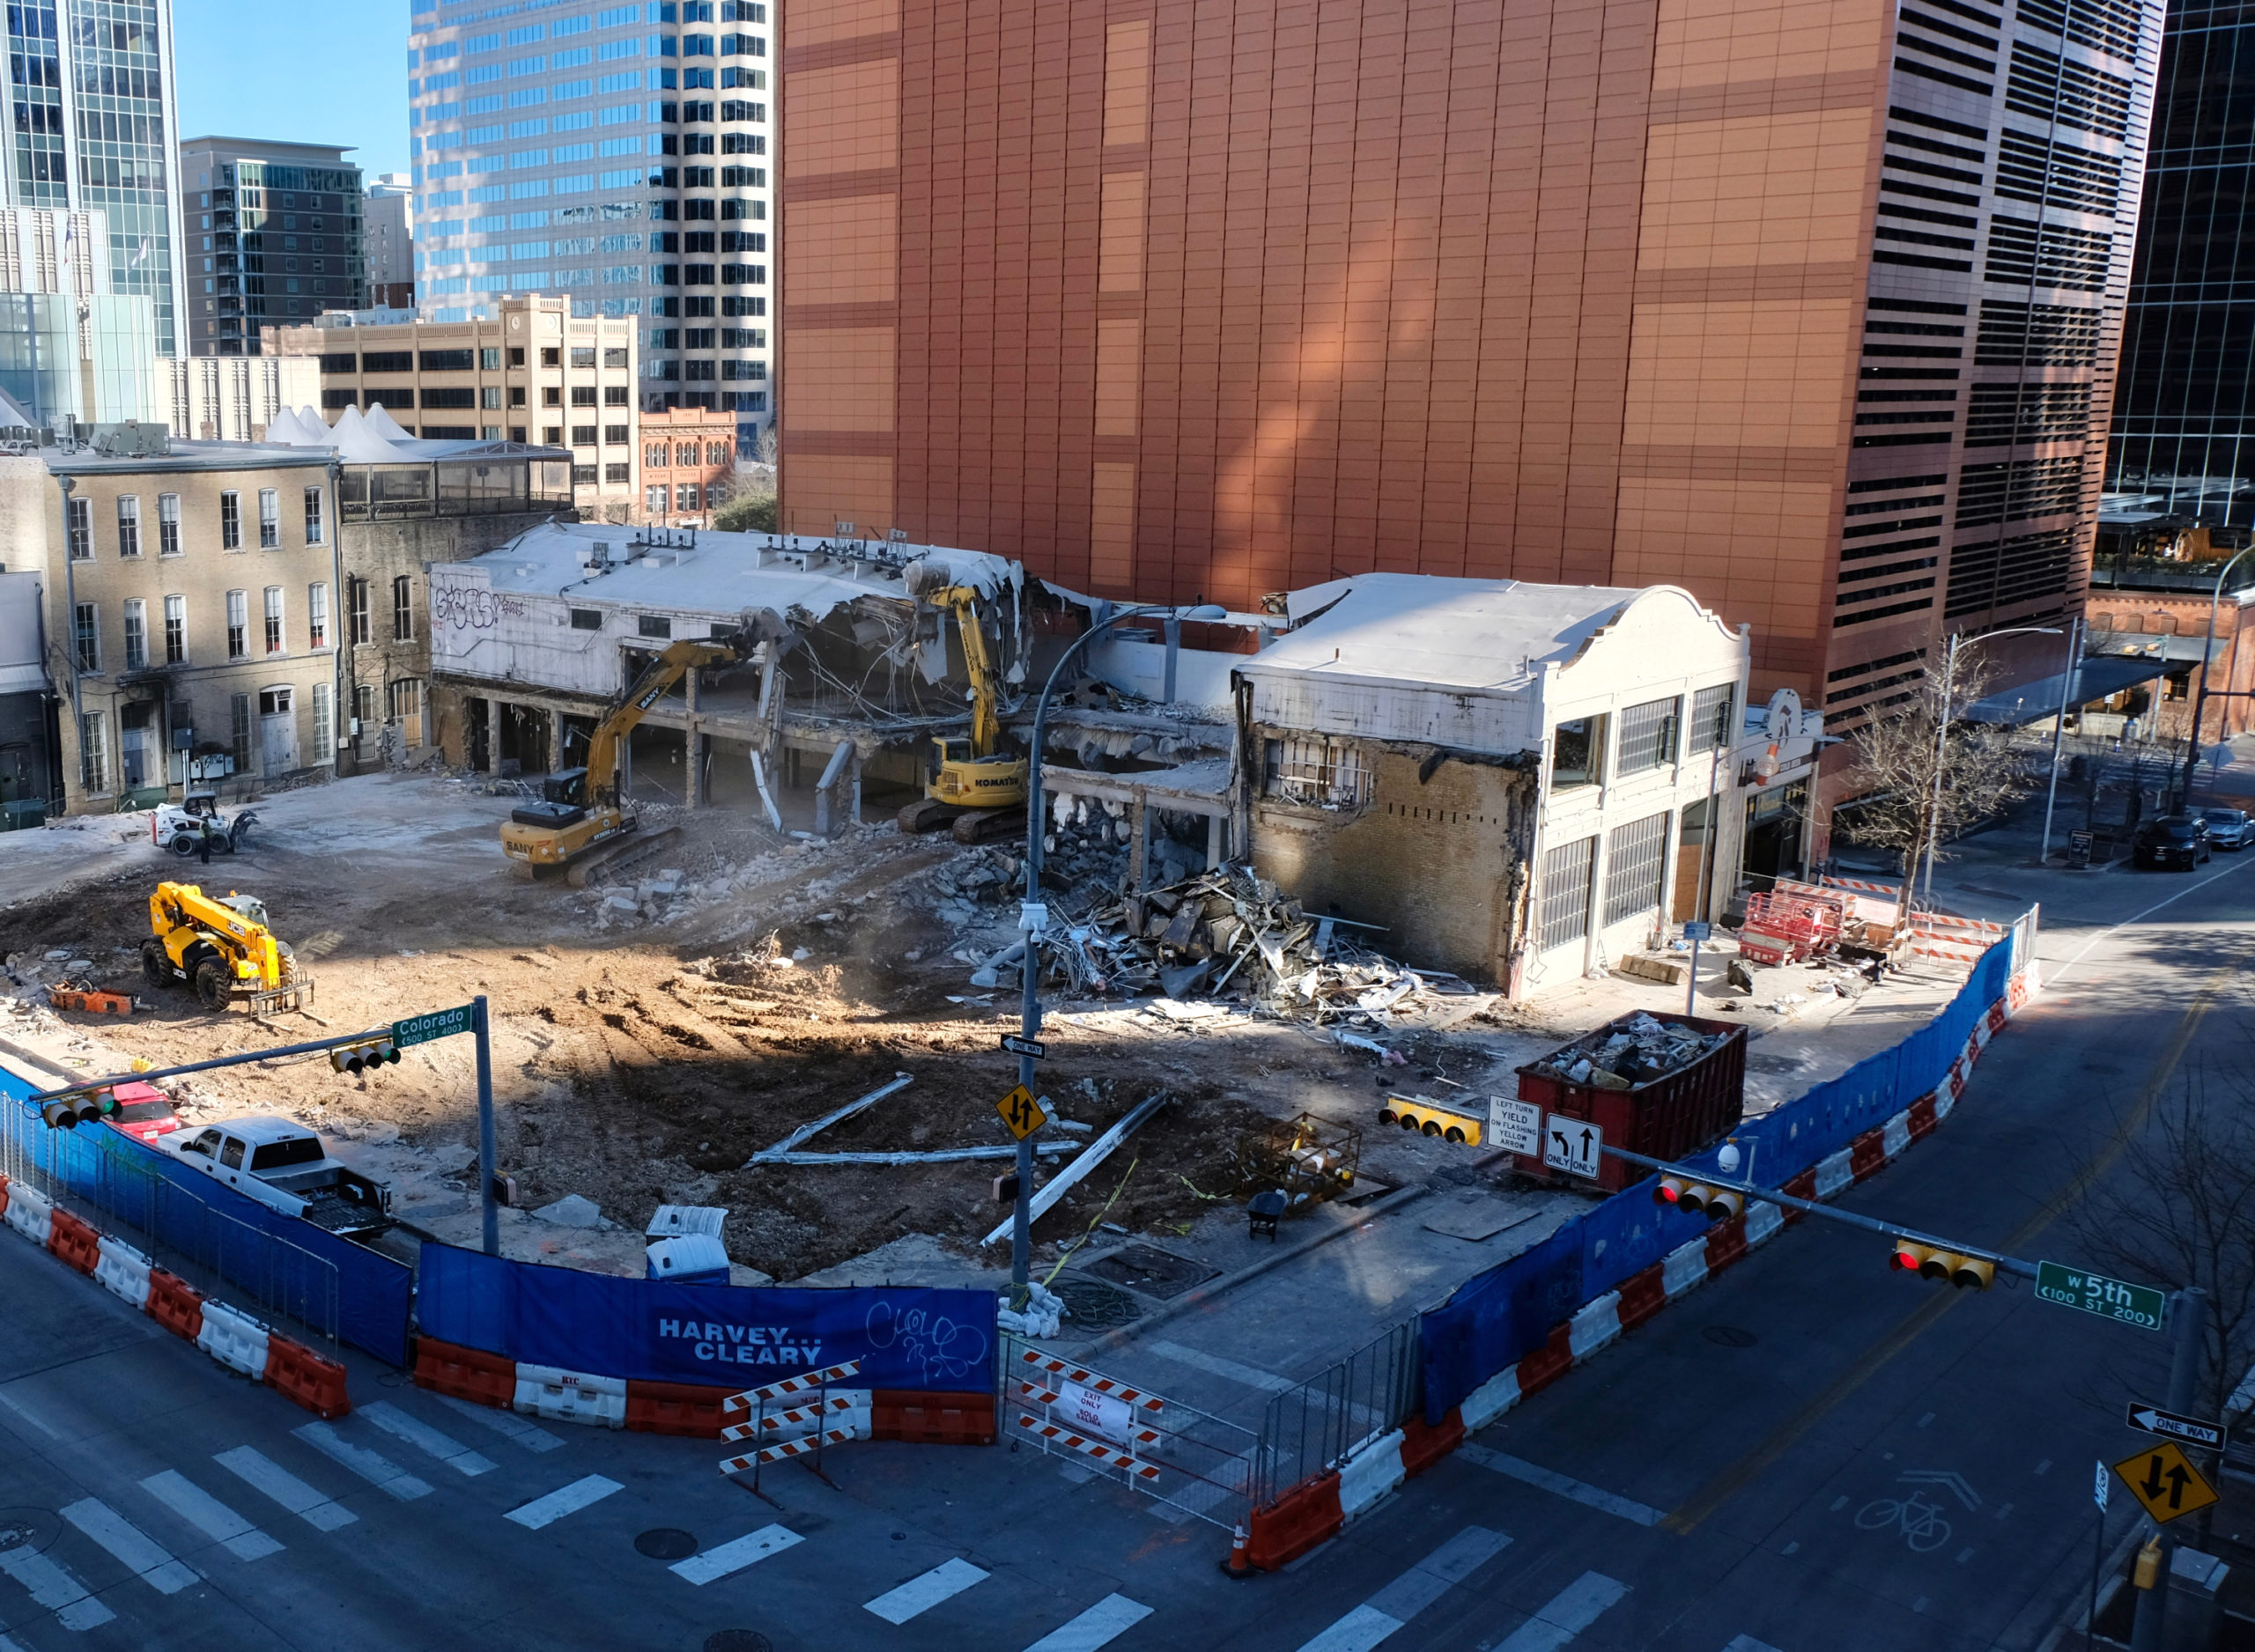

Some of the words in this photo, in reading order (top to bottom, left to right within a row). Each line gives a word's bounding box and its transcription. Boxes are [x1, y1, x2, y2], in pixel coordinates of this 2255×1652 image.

[640, 687, 661, 709] SANY
[975, 776, 1019, 787] KOMATSU
[506, 841, 535, 855] SANY
[227, 920, 246, 937] JCB
[173, 969, 187, 980] JCB
[400, 1010, 464, 1036] Colorado
[406, 1034, 423, 1045] 500
[427, 1029, 437, 1039] ST
[441, 1025, 458, 1036] 400
[1027, 1045, 1041, 1054] WAY
[1496, 1100, 1512, 1110] LEFT
[1515, 1103, 1533, 1114] TURN
[1501, 1110, 1527, 1125] YIELD
[1499, 1130, 1527, 1141] YELLOW
[1503, 1122, 1537, 1136] FLASHING
[1500, 1139, 1525, 1150] ARROW
[1547, 1154, 1570, 1167] ONLY
[1573, 1161, 1596, 1174] ONLY
[2066, 1275, 2081, 1288] W
[2085, 1276, 2133, 1307] 5th
[2050, 1288, 2076, 1304] 100
[2086, 1298, 2104, 1312] ST
[2114, 1306, 2146, 1324] 200
[695, 1341, 822, 1366] CLEARY
[1083, 1391, 1102, 1402] EXIT
[1080, 1398, 1102, 1410] ONLY
[1079, 1408, 1098, 1420] SOLO
[2155, 1418, 2183, 1433] ONE
[2186, 1426, 2214, 1441] WAY
